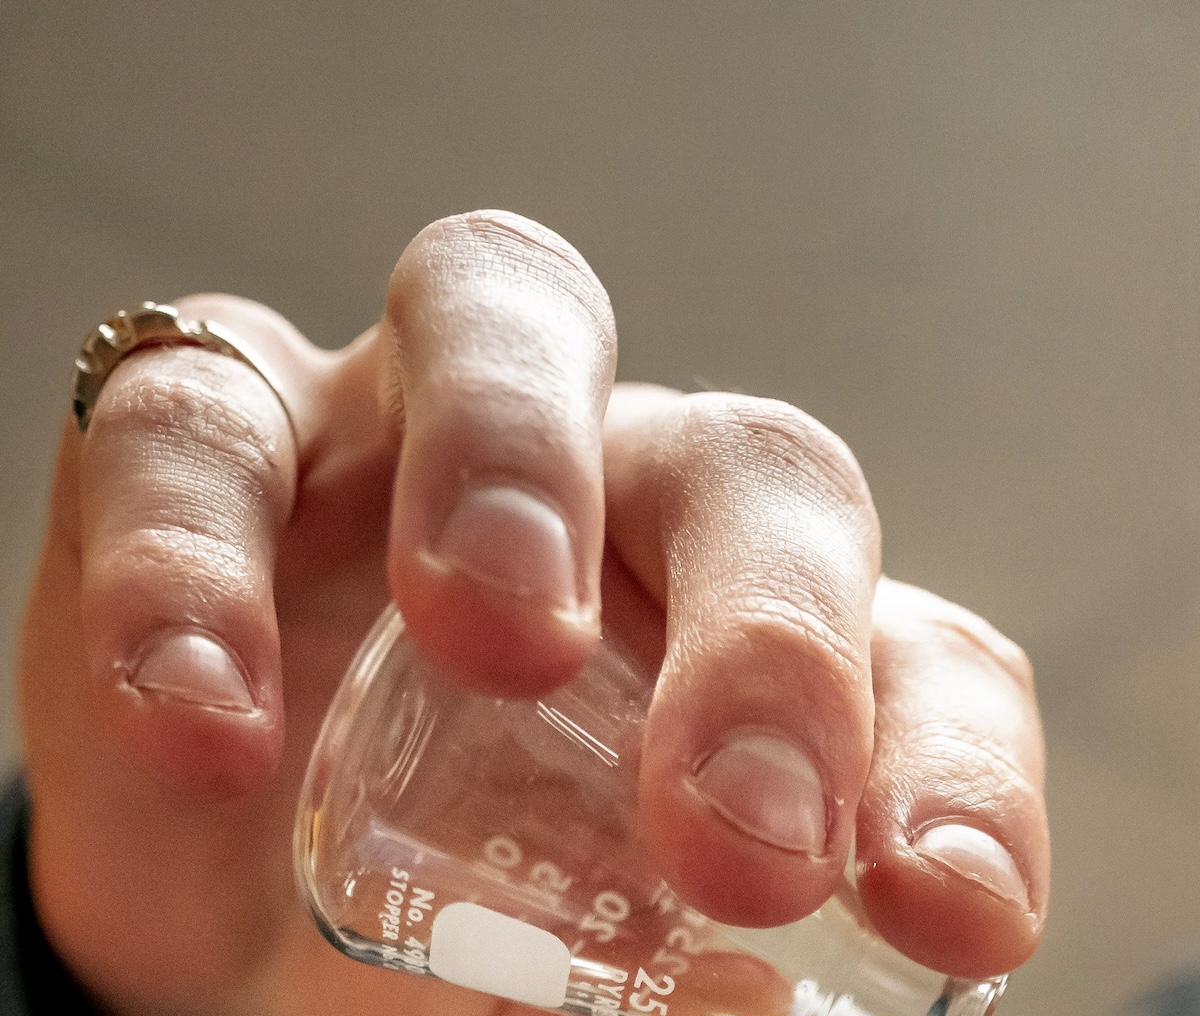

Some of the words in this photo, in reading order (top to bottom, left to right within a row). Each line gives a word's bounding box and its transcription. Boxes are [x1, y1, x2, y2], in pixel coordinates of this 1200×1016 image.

[378, 867, 410, 941] STOPPER
[406, 887, 436, 927] No.
[629, 967, 675, 1016] 25
